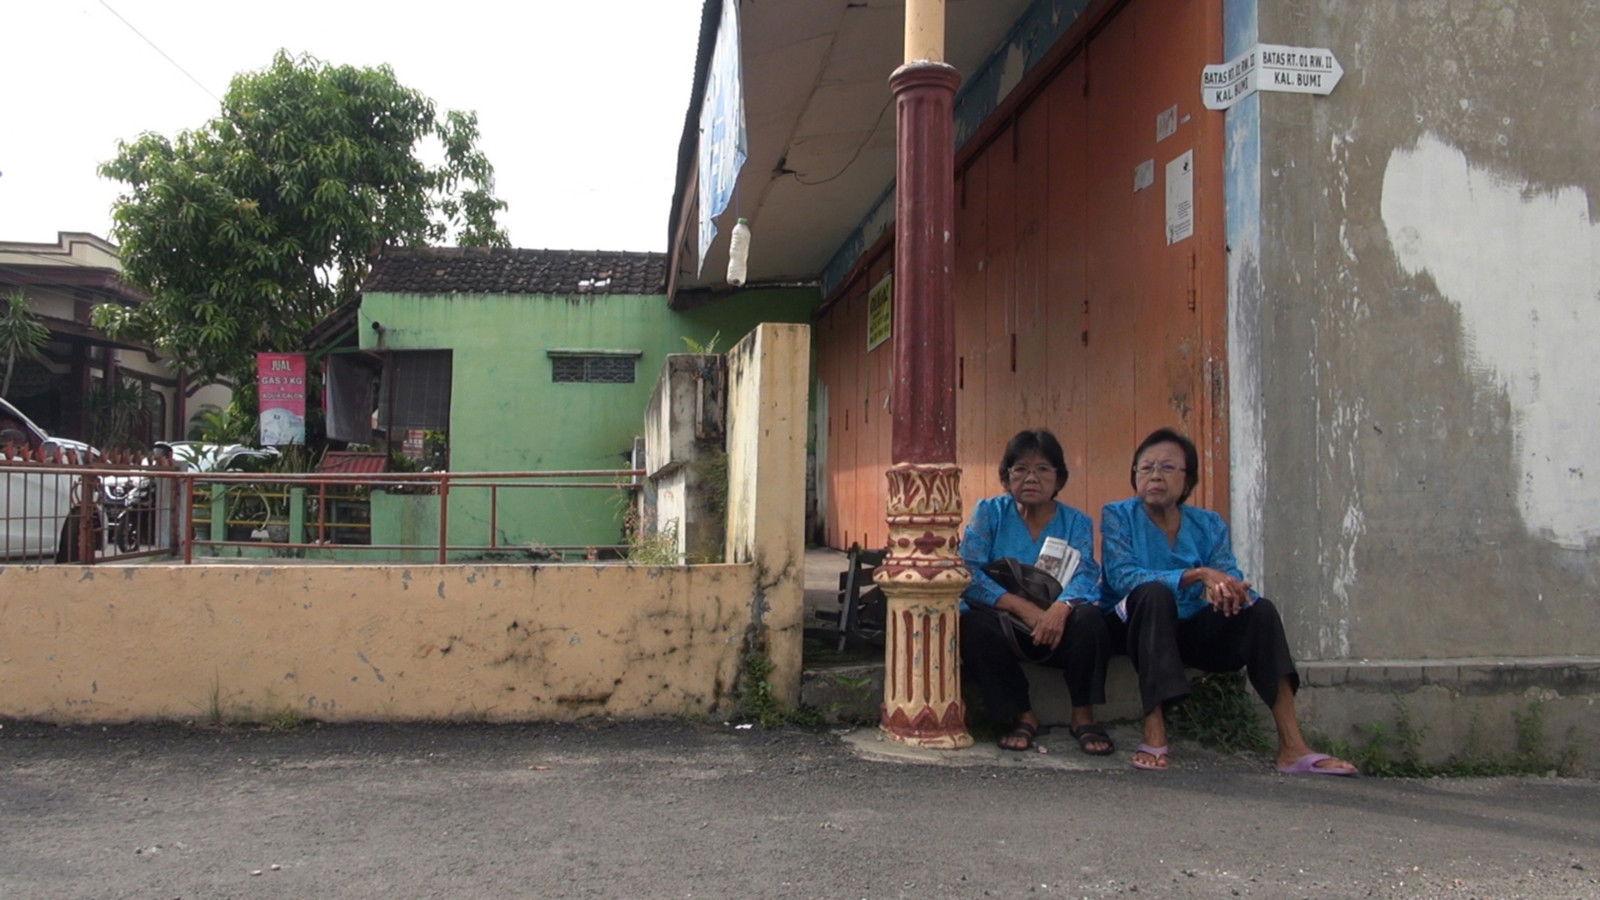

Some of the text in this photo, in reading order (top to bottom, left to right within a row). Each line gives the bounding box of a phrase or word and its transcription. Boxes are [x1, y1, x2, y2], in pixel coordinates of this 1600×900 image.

[1262, 52, 1332, 68] BATAS RT. 01 RW. II
[1204, 72, 1227, 84] BATAS
[1274, 72, 1321, 87] KAL. BUMI
[1216, 88, 1233, 102] KAL.
[272, 360, 292, 371] JUAL
[261, 376, 280, 385] GAS
